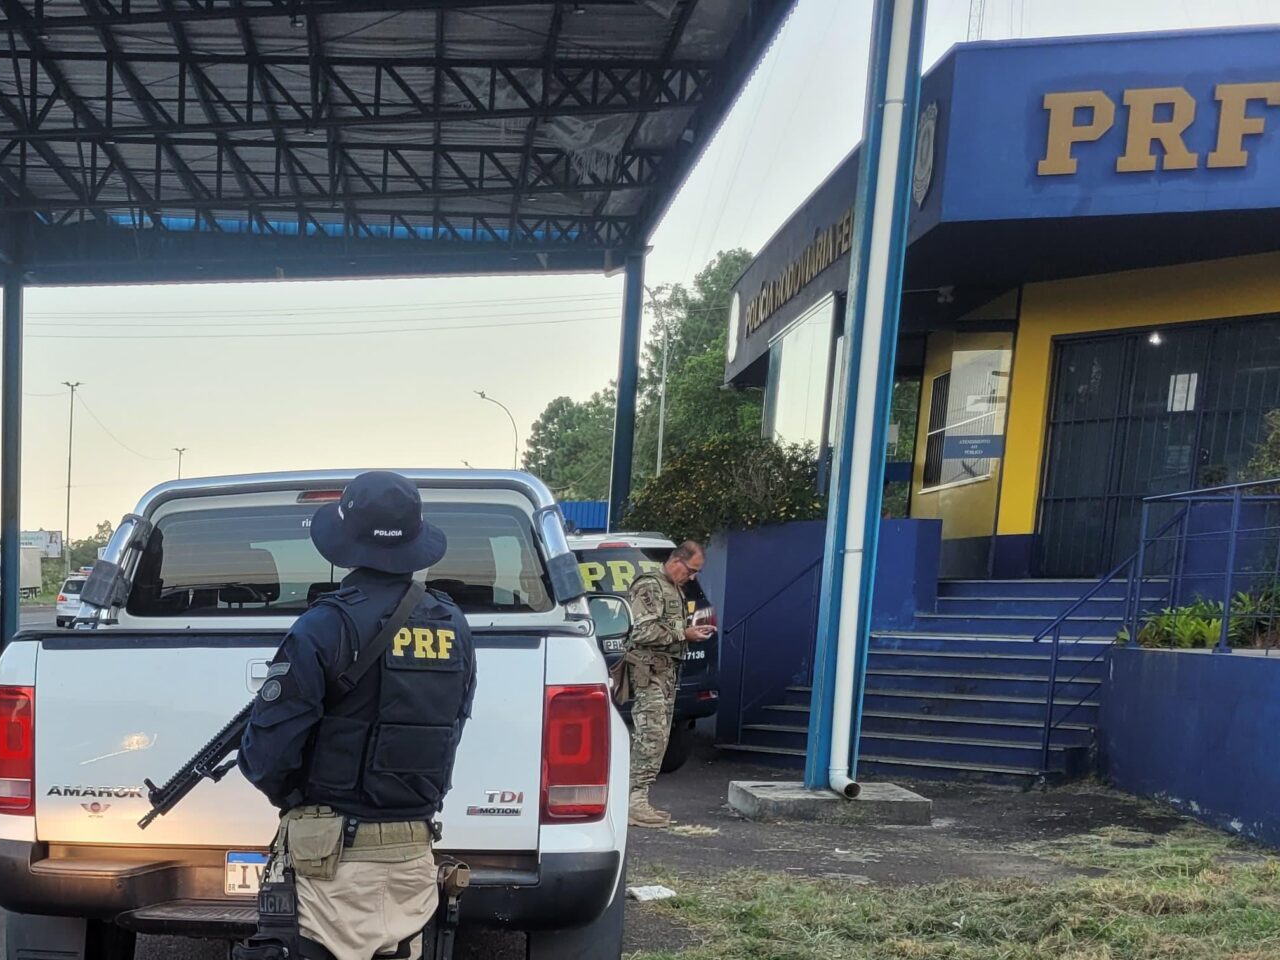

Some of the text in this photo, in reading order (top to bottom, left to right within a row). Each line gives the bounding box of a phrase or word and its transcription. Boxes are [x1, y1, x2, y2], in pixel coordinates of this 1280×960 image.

[1038, 81, 1280, 175] PRF
[834, 207, 854, 260] FE
[392, 627, 455, 660] PRF
[46, 785, 144, 798] AMAROK
[484, 789, 524, 804] TDI
